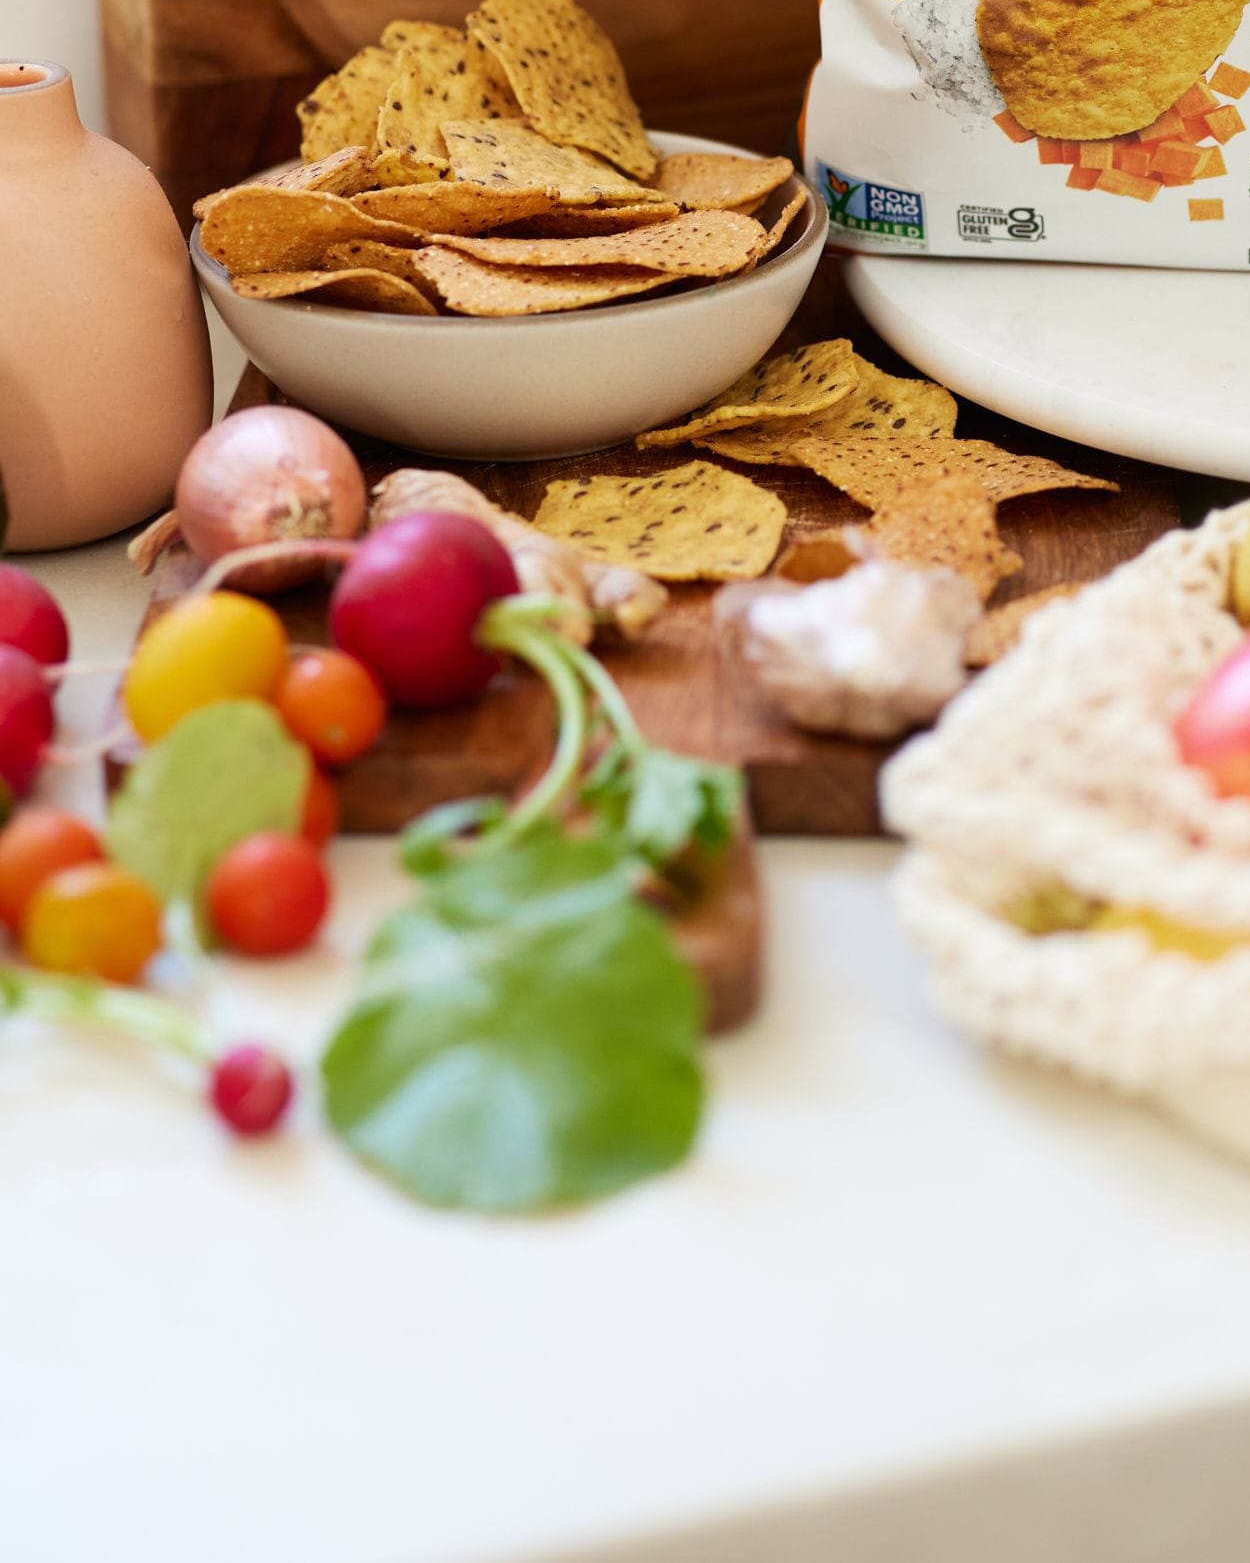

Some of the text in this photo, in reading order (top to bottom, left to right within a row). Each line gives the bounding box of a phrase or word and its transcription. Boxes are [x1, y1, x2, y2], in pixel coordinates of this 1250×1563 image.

[870, 187, 917, 205] NON
[870, 199, 920, 215] GMO
[962, 214, 1008, 226] GLUTEN
[963, 224, 990, 235] FREE
